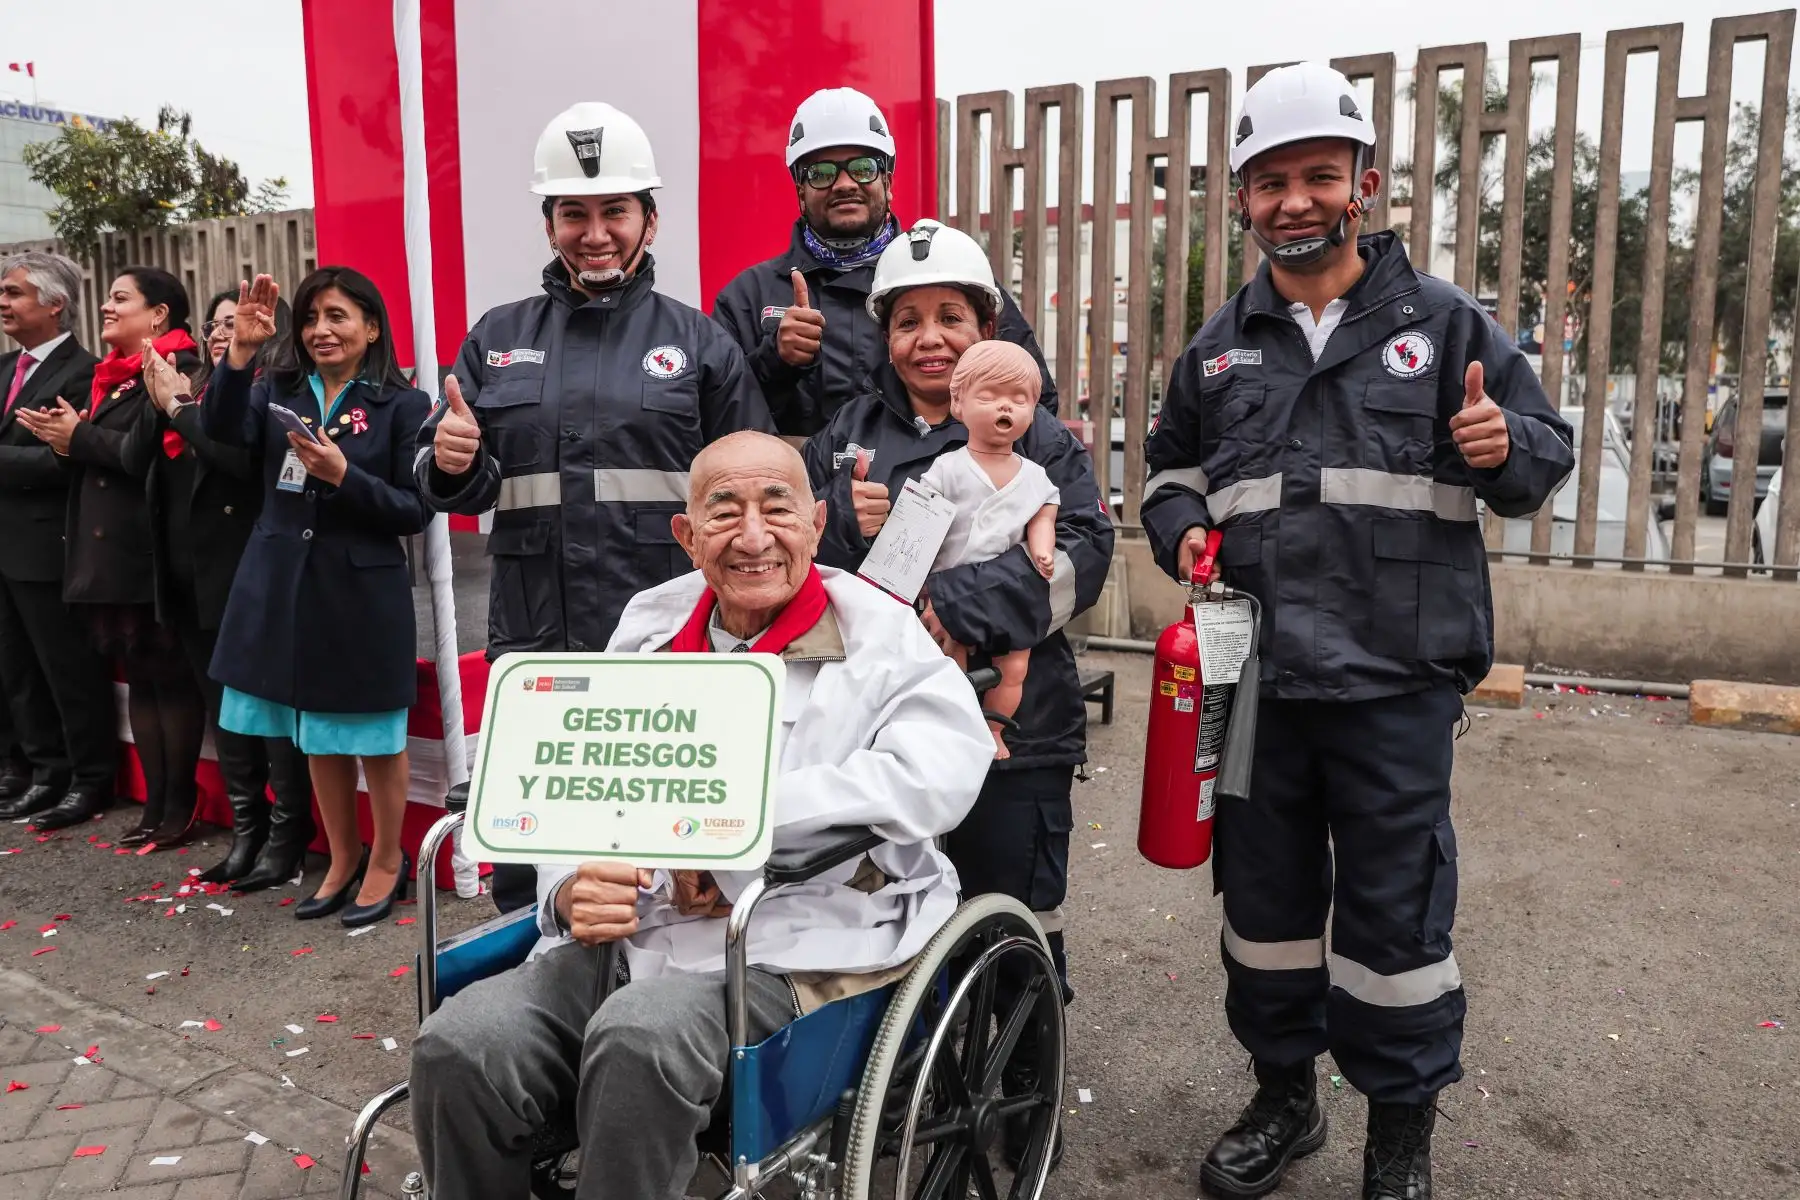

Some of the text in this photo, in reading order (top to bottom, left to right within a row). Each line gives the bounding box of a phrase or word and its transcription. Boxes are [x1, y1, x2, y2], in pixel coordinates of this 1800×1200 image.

[562, 703, 697, 732] GESTIÓN
[535, 741, 717, 768] DE RIESGOS
[518, 775, 727, 804] Y DESASTRES
[704, 818, 745, 828] UGRED
